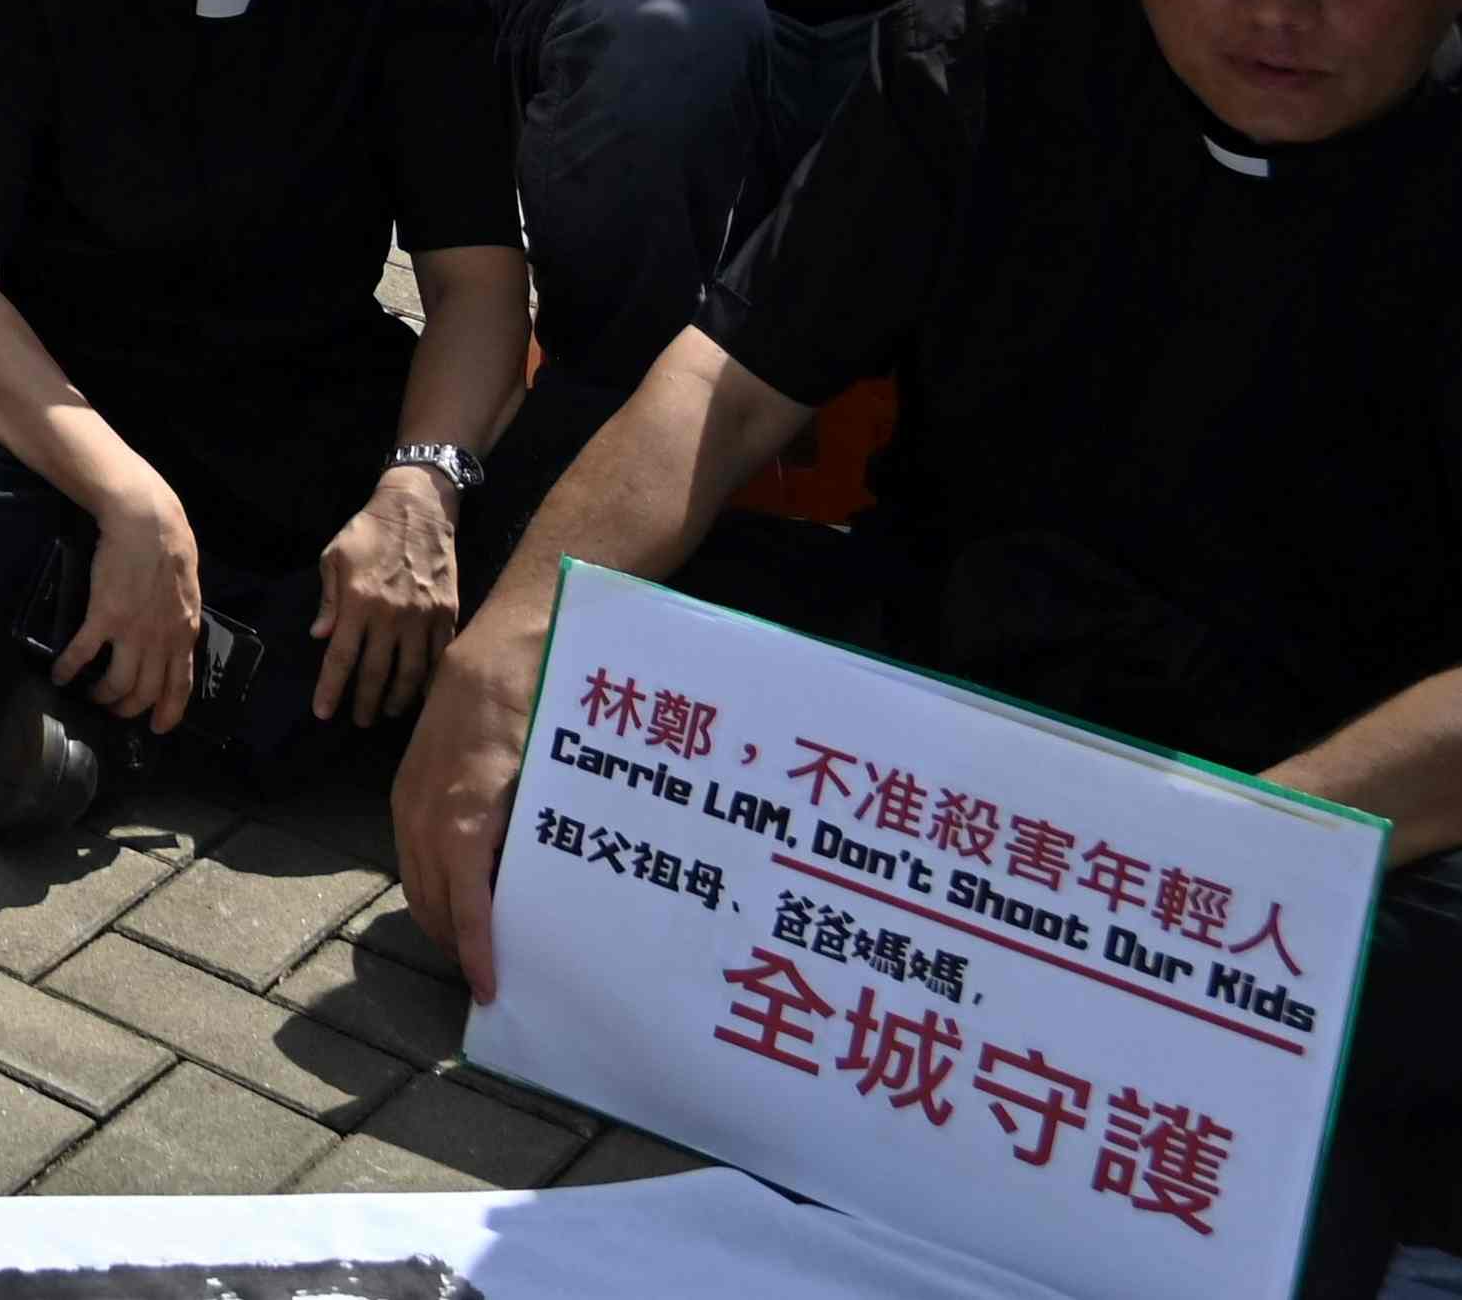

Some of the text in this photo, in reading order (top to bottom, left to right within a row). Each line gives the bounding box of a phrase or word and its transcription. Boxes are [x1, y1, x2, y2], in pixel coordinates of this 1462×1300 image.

[552, 729, 1316, 1032] Carrie LAM, Don't Shoot Our Kids
[713, 946, 1236, 1236] 全城守護
